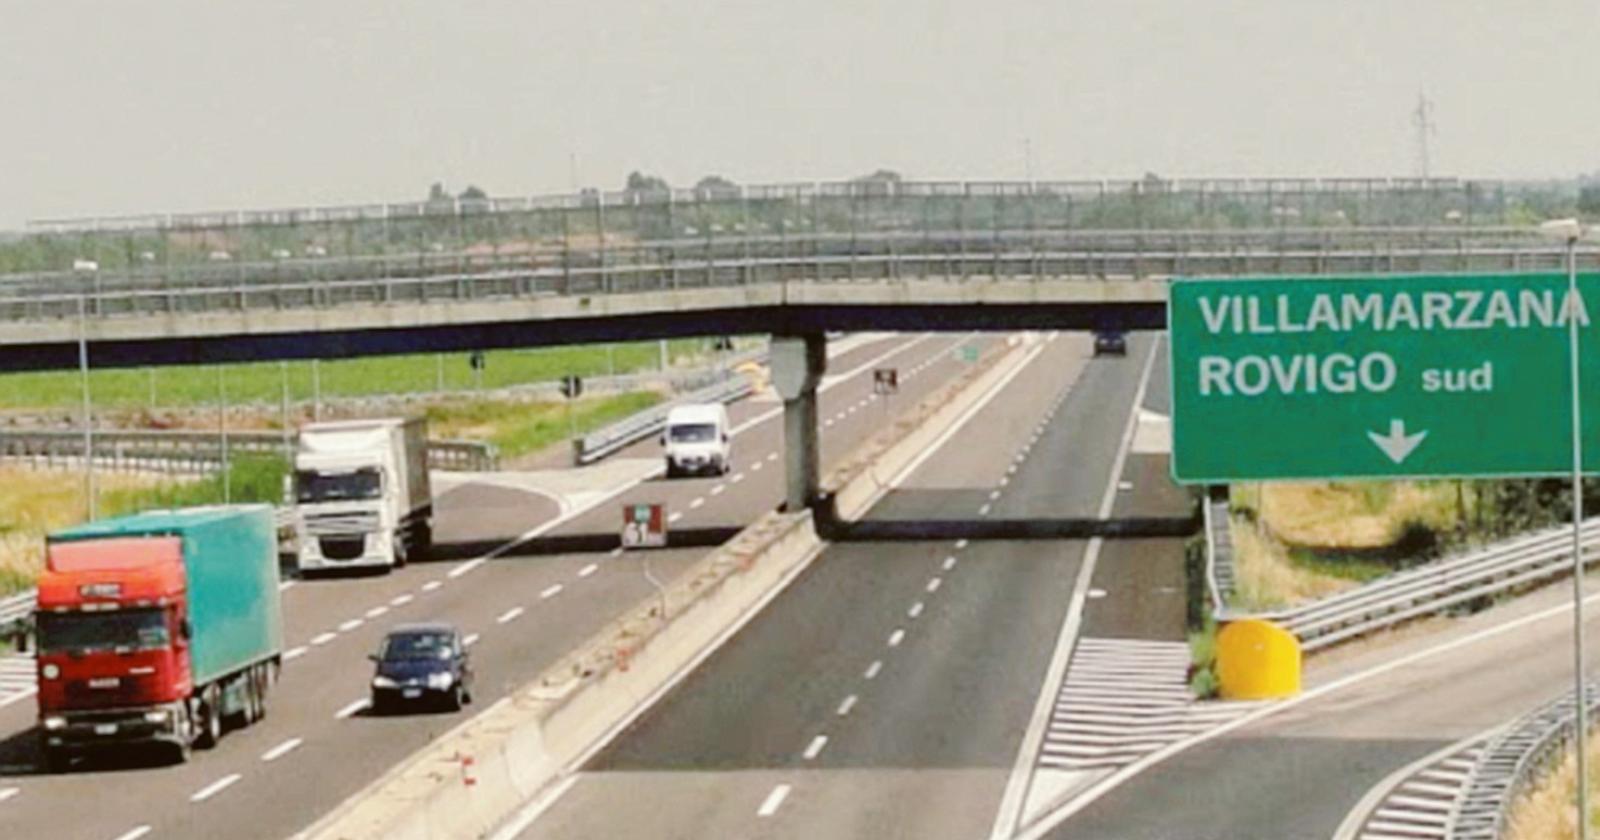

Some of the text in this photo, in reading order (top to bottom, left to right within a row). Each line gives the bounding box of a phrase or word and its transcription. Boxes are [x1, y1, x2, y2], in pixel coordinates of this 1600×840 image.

[1198, 289, 1590, 334] VILLAMARZANA
[1200, 352, 1493, 395] ROVIGO sud
